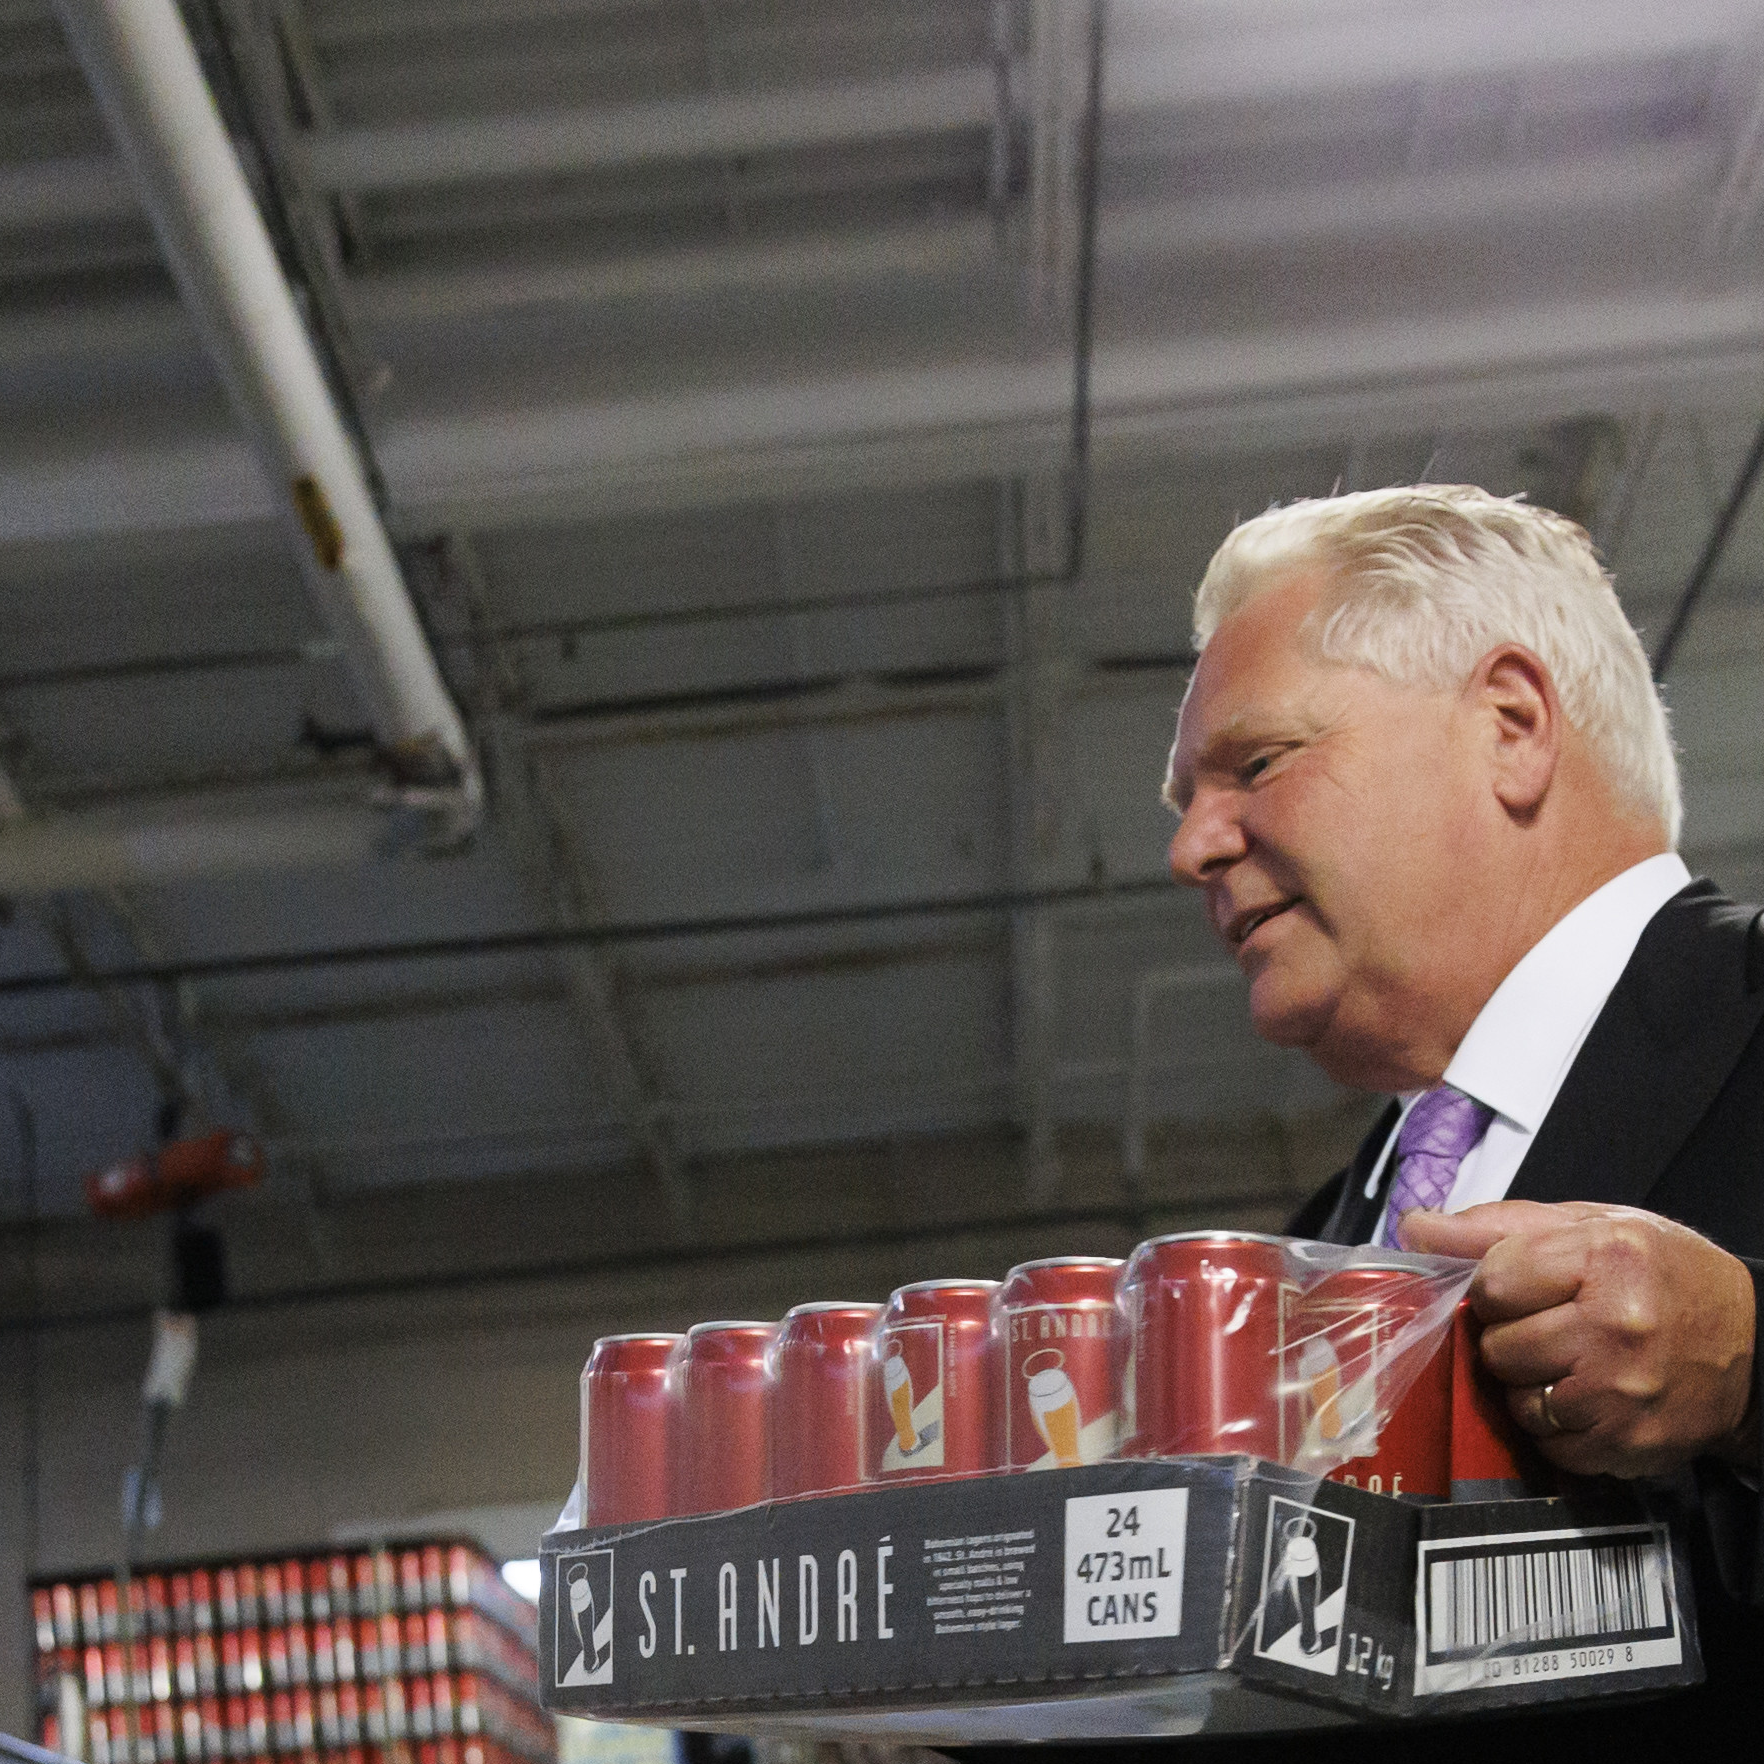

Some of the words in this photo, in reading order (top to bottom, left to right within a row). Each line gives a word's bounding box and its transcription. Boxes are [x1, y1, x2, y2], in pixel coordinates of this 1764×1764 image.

[1106, 1505, 1141, 1538] 24
[1076, 1547, 1173, 1584] 473mL
[638, 1567, 695, 1659] ST.
[718, 1534, 895, 1652] ANDRÉ
[1087, 1591, 1158, 1627] CANS
[1345, 1632, 1373, 1676] 12
[1513, 1656, 1560, 1676] 81288
[1570, 1647, 1615, 1669] 50029
[1625, 1645, 1634, 1662] 8
